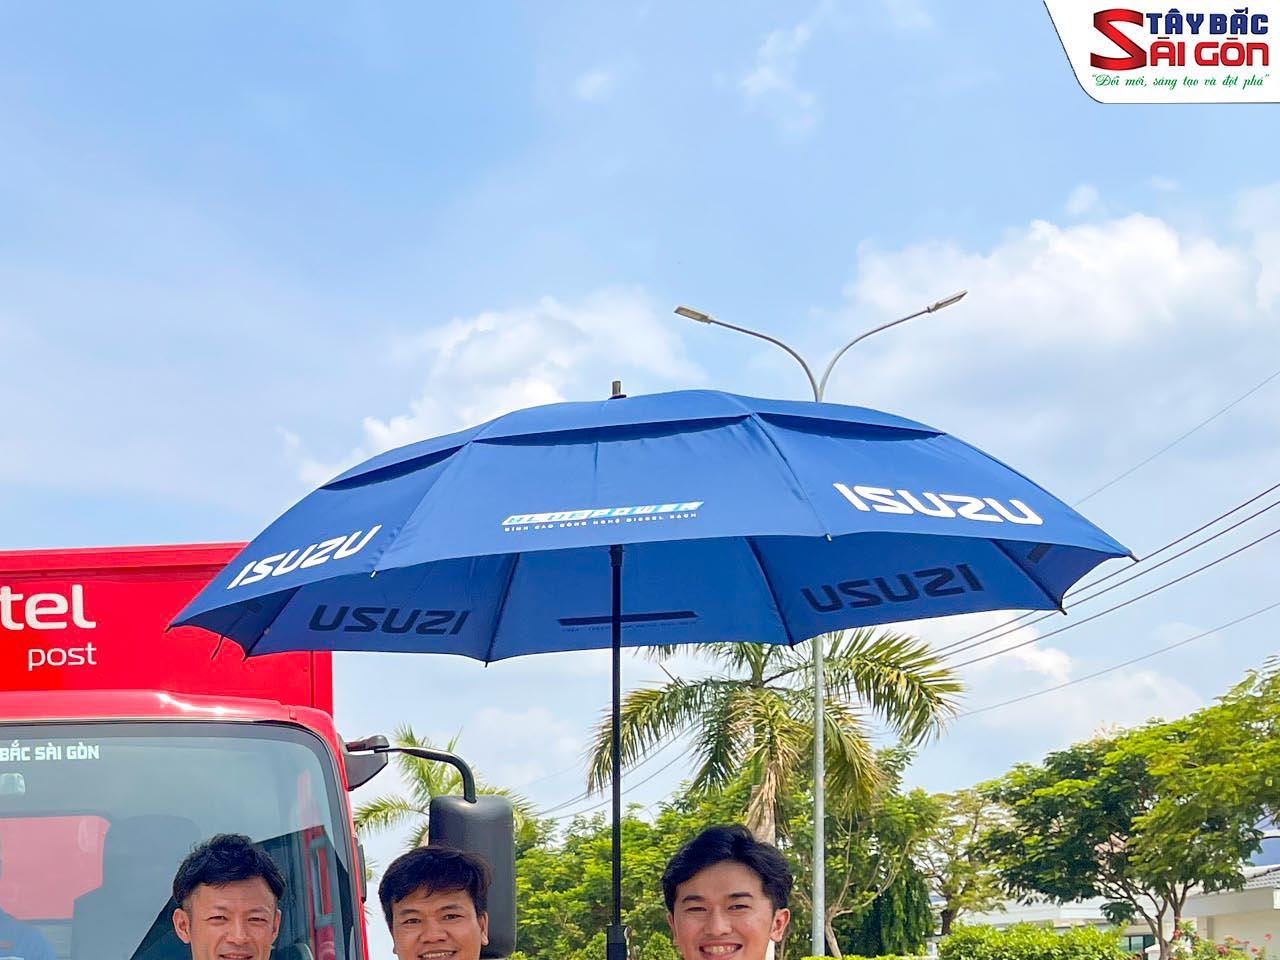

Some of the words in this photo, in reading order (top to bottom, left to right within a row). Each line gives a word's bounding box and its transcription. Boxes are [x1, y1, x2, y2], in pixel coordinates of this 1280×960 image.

[832, 483, 1043, 525] ISUZU
[226, 524, 382, 589] ISUZU
[28, 642, 97, 671] post
[0, 740, 30, 761] BẮC
[35, 743, 61, 760] SÀI
[67, 742, 99, 760] GÒN
